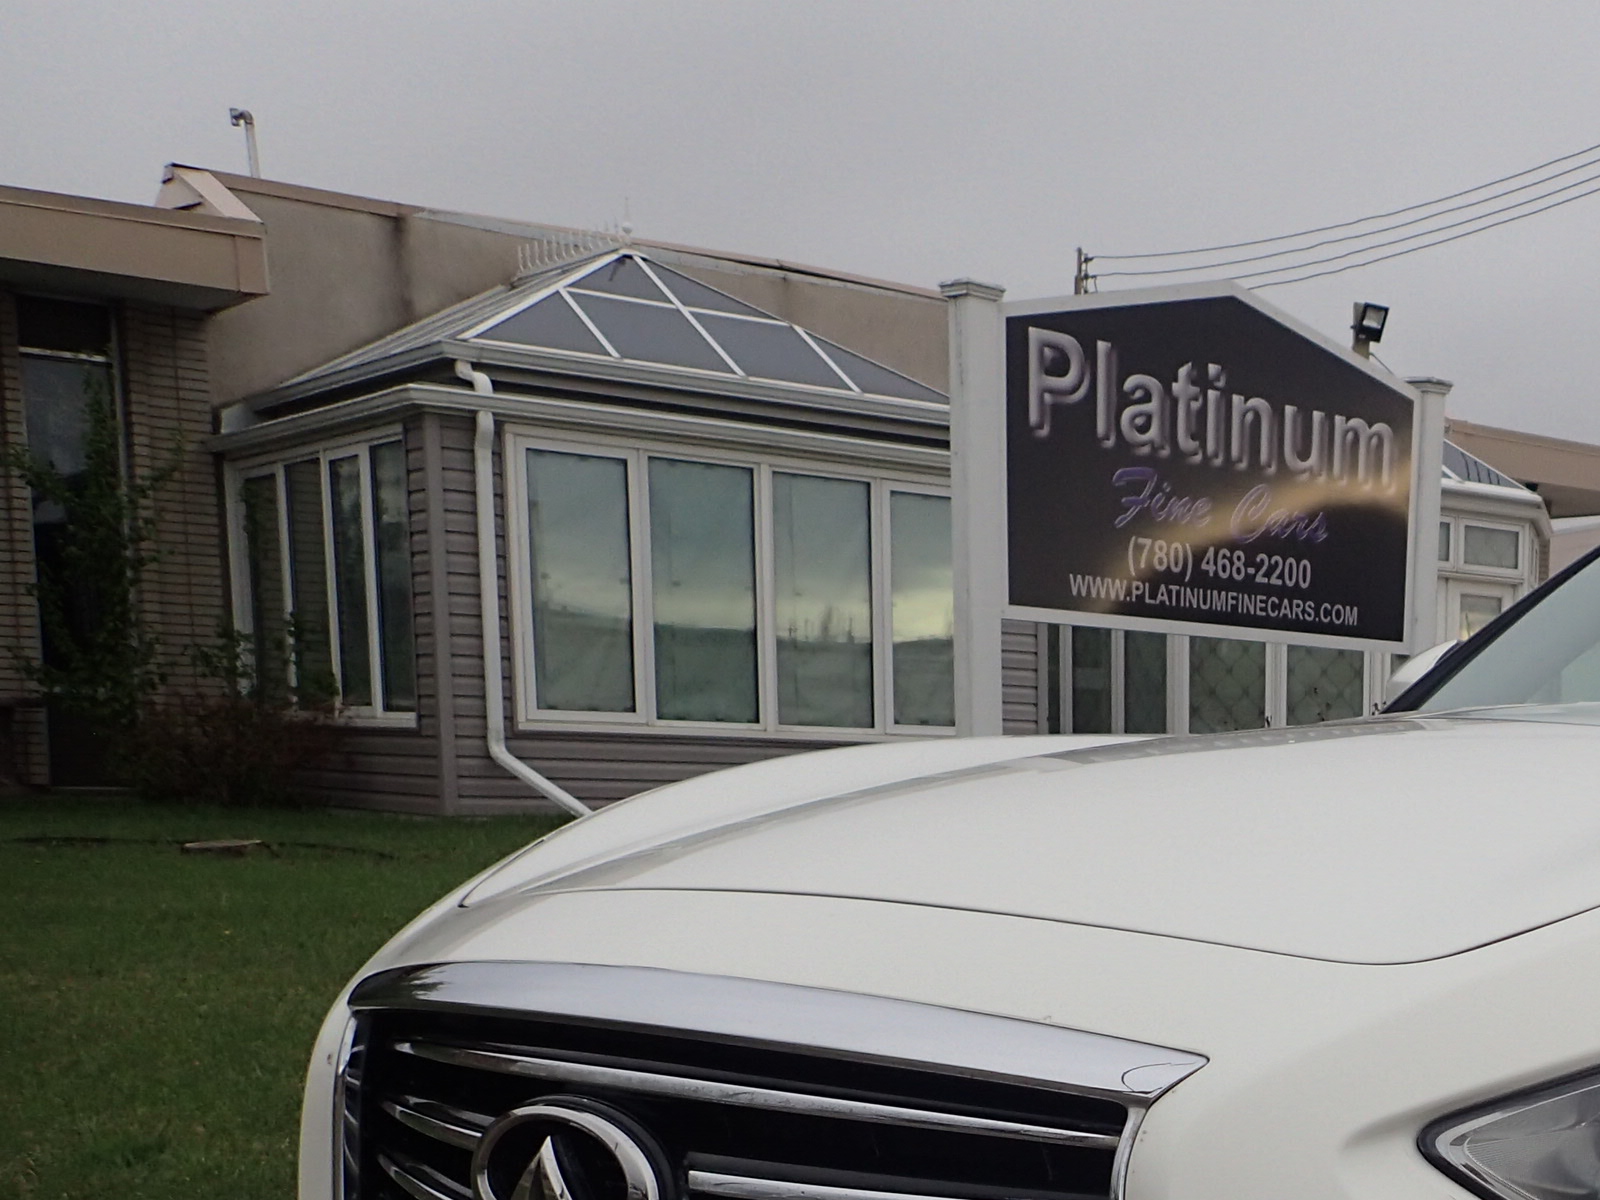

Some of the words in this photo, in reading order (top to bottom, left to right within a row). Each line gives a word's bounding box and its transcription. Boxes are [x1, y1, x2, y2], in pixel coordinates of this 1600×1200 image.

[1027, 326, 1396, 495] Platinum
[1112, 467, 1213, 528] Fine
[1231, 484, 1328, 543] Cars
[1127, 536, 1193, 582] (780)
[1201, 549, 1311, 589] 468-2200
[1069, 574, 1358, 626] WWW.PLATINUMFINECARS.COM
